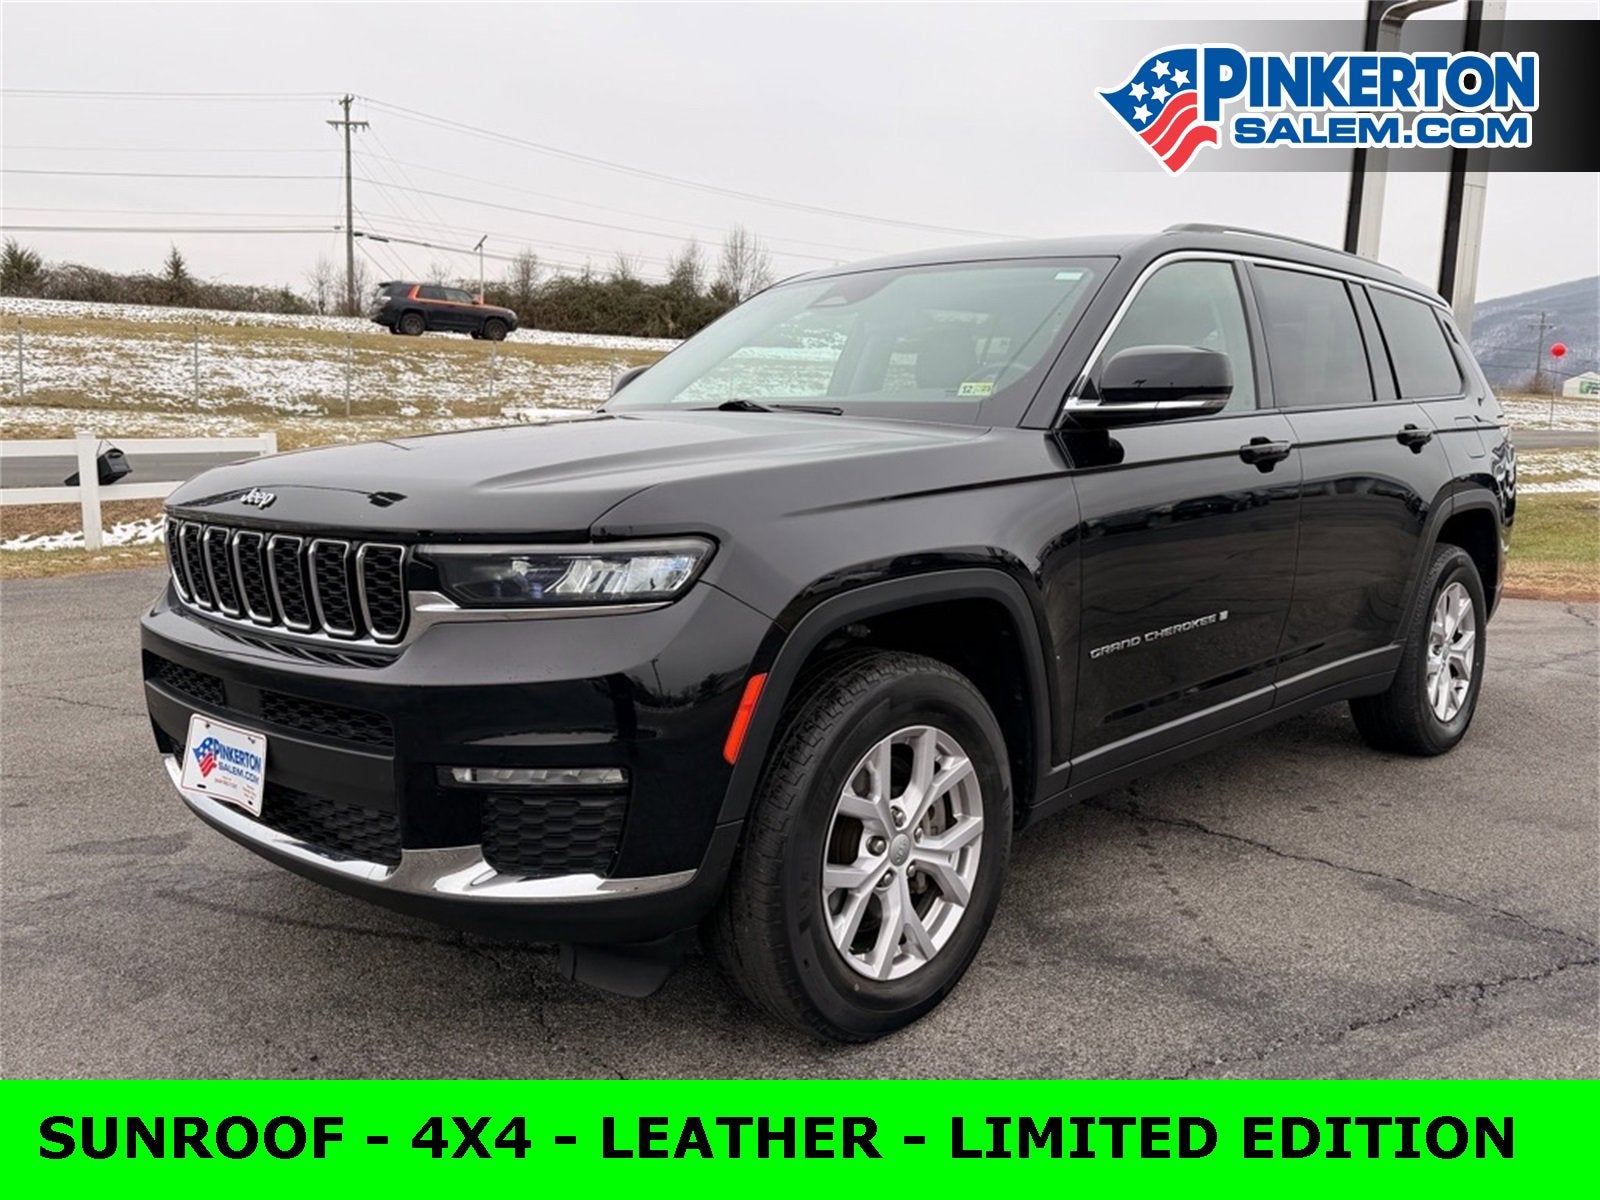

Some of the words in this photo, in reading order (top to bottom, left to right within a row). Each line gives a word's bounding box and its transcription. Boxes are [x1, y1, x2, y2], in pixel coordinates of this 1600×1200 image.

[962, 385, 973, 394] 12
[240, 487, 275, 508] Jeep
[1089, 635, 1142, 659] GRAND
[1144, 613, 1218, 642] CHEROKEE
[213, 738, 262, 774] PINKERTON
